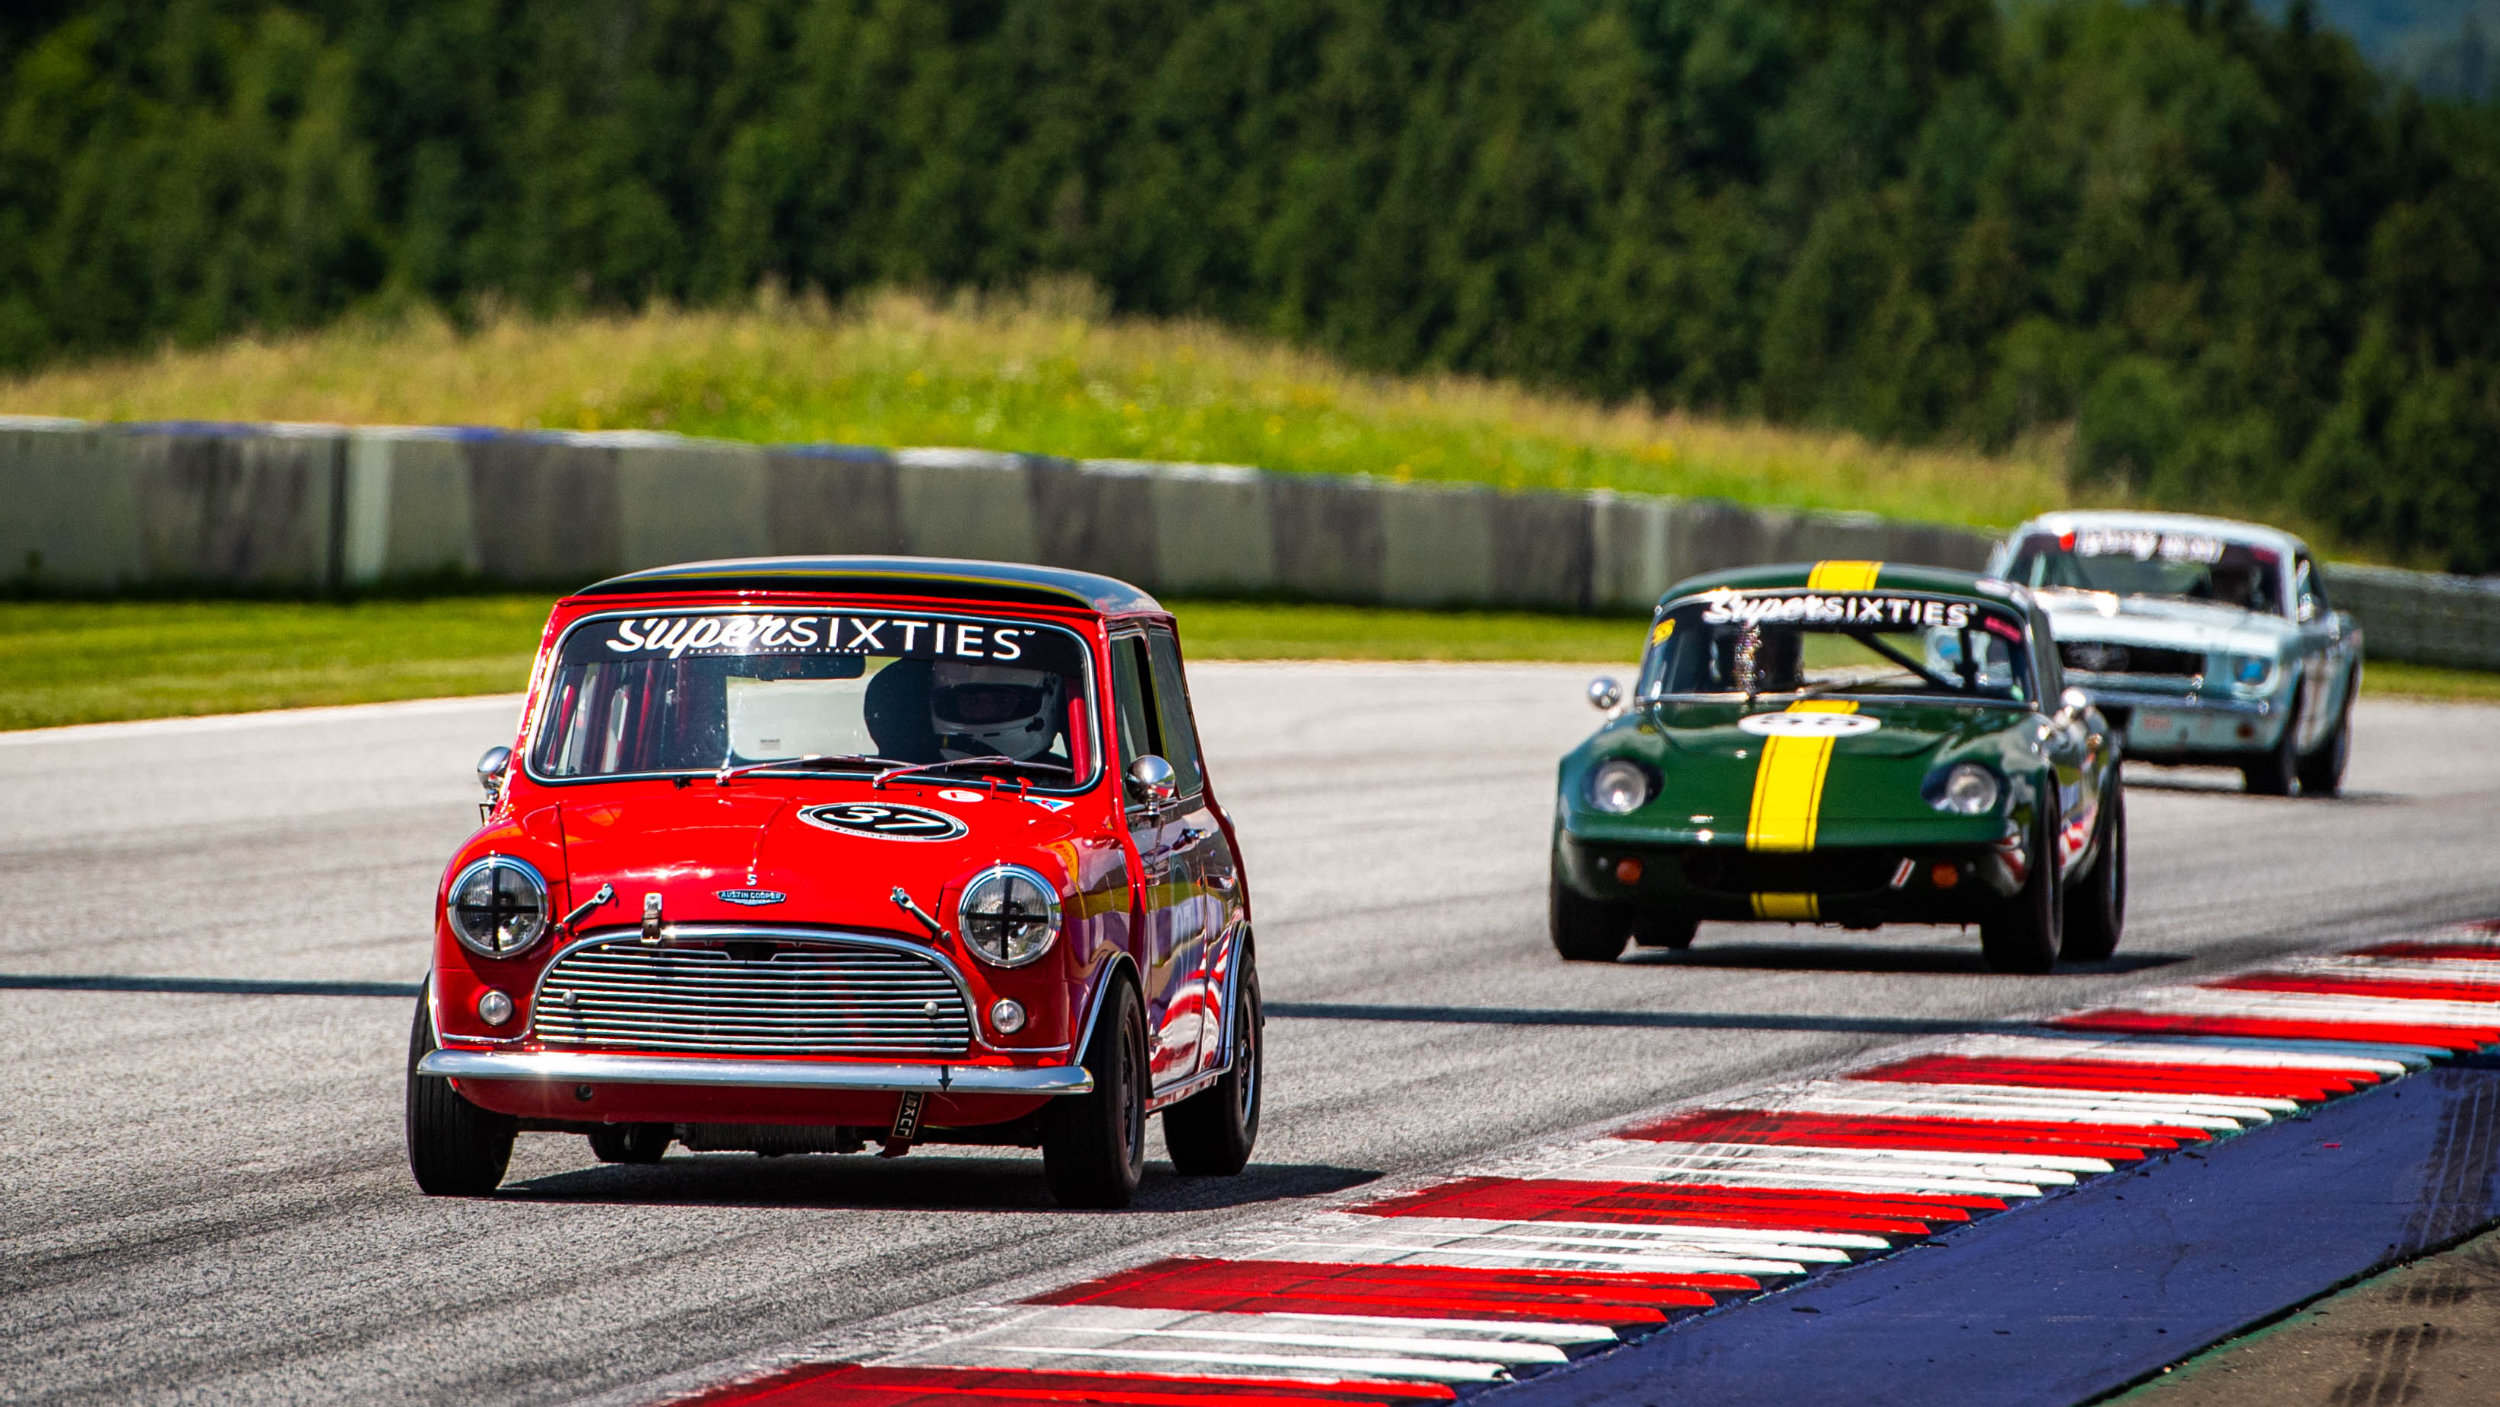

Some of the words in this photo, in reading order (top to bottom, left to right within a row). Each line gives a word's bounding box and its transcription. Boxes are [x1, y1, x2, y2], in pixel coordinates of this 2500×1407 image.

[822, 806, 947, 831] 37
[746, 874, 757, 885] S
[721, 891, 748, 899] AUSTIN
